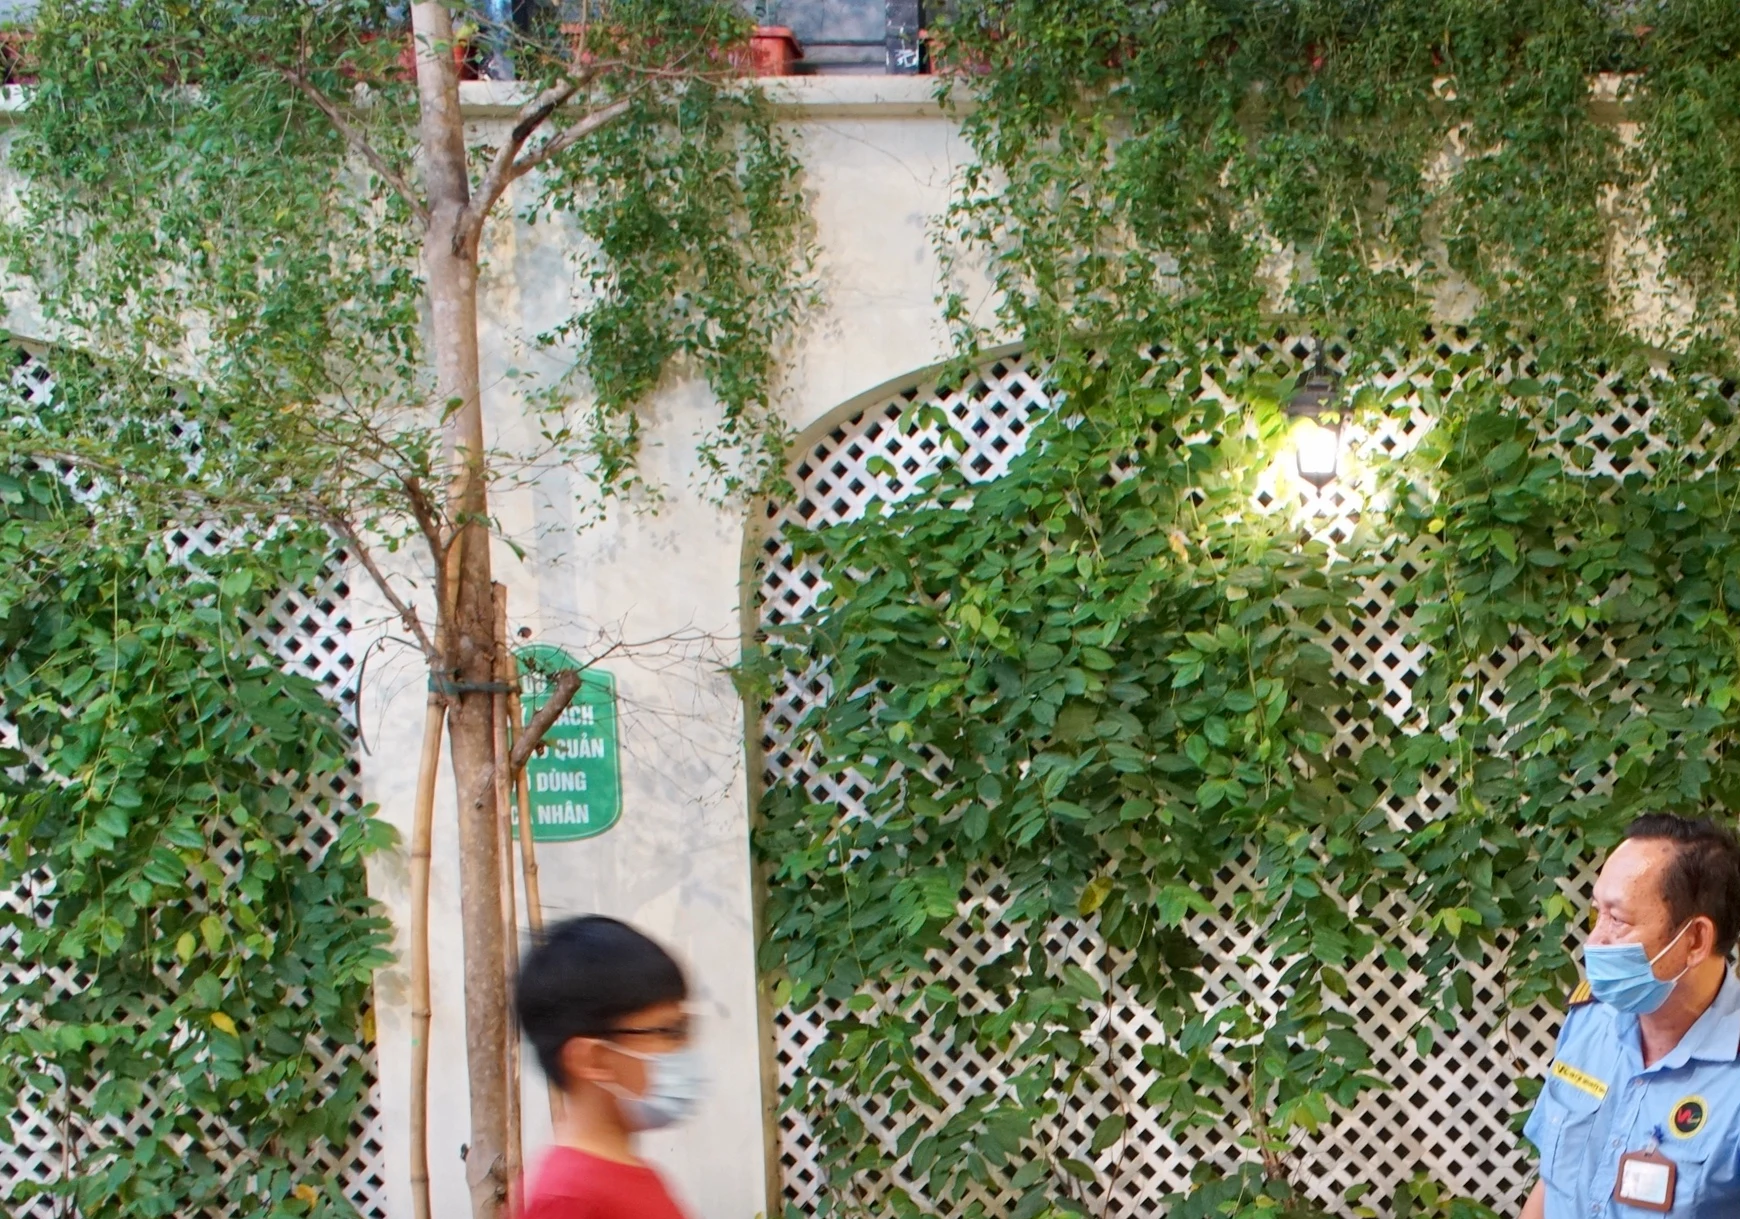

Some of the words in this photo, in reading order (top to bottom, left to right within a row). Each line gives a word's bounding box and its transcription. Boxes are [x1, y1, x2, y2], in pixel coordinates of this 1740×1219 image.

[554, 732, 606, 762] QUẢN
[536, 767, 588, 793] DÙNG
[537, 800, 590, 825] NHÂN
